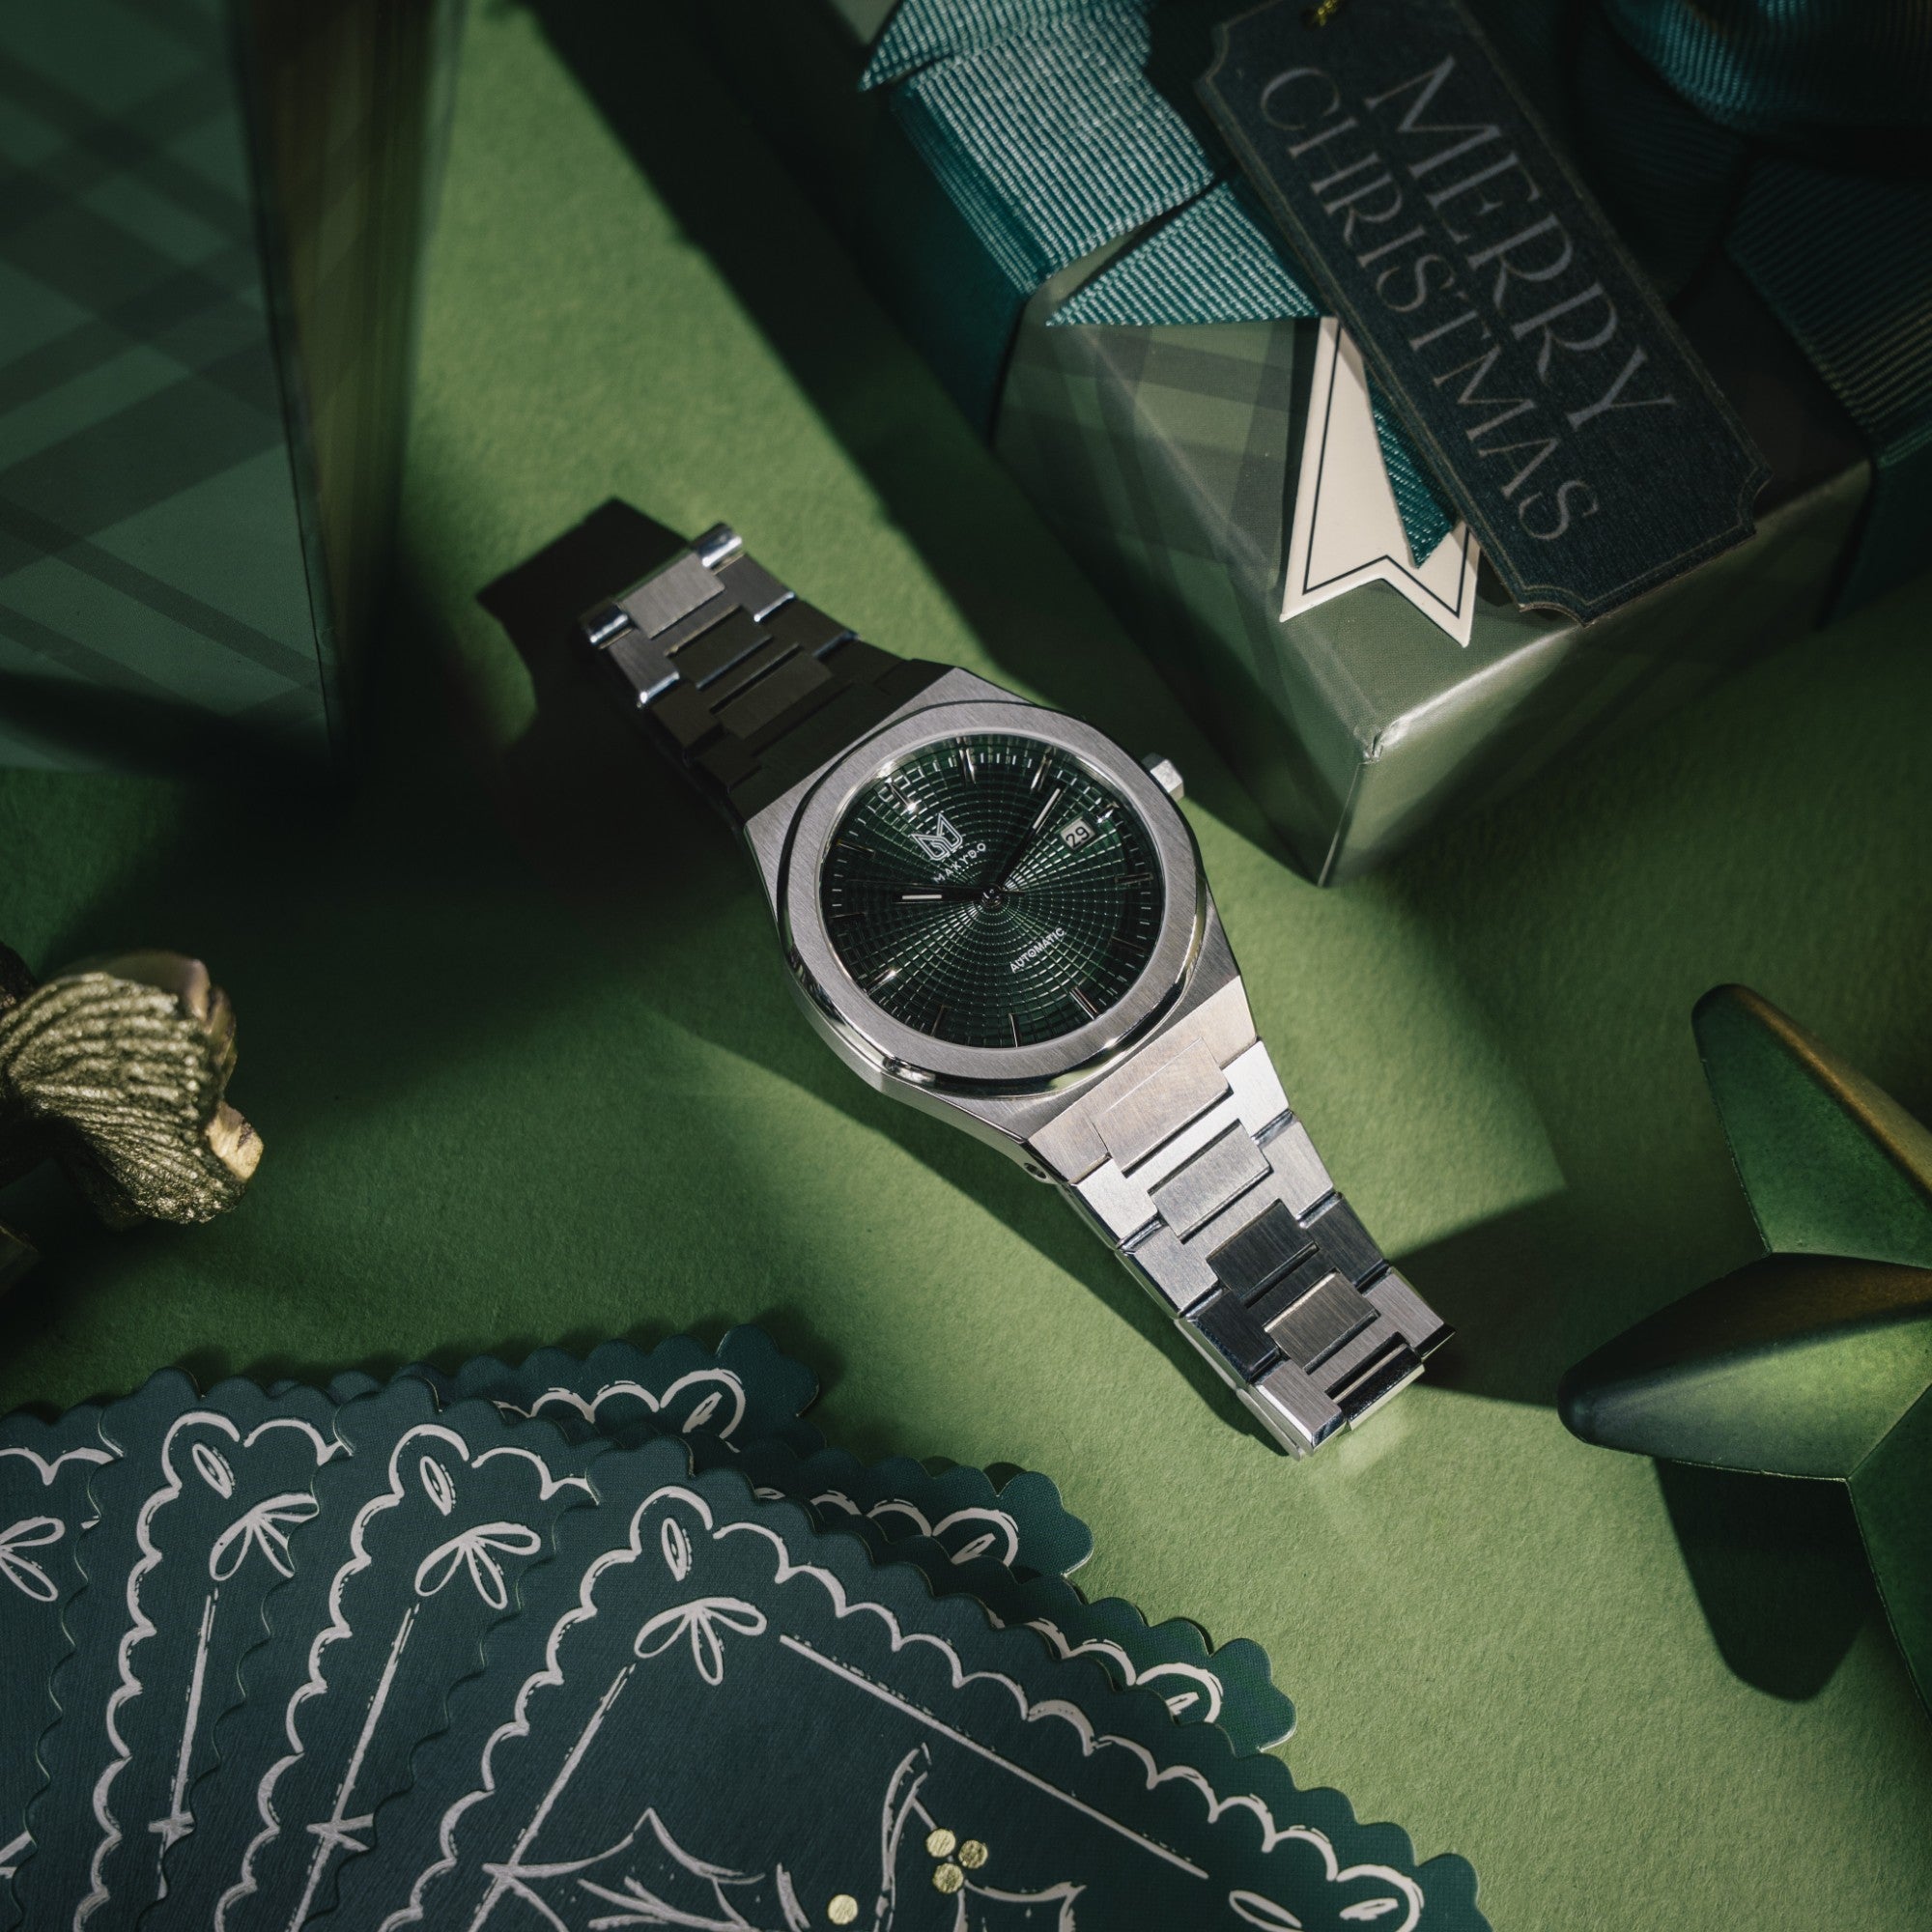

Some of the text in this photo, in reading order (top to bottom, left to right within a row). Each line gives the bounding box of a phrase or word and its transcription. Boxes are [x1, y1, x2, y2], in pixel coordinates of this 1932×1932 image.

[1366, 55, 1677, 432] MERRY
[1260, 67, 1600, 542] CHRISTMAS
[1065, 826, 1090, 847] 29
[933, 842, 986, 883] MAKYDO
[1010, 927, 1065, 974] AUTOMATIC
